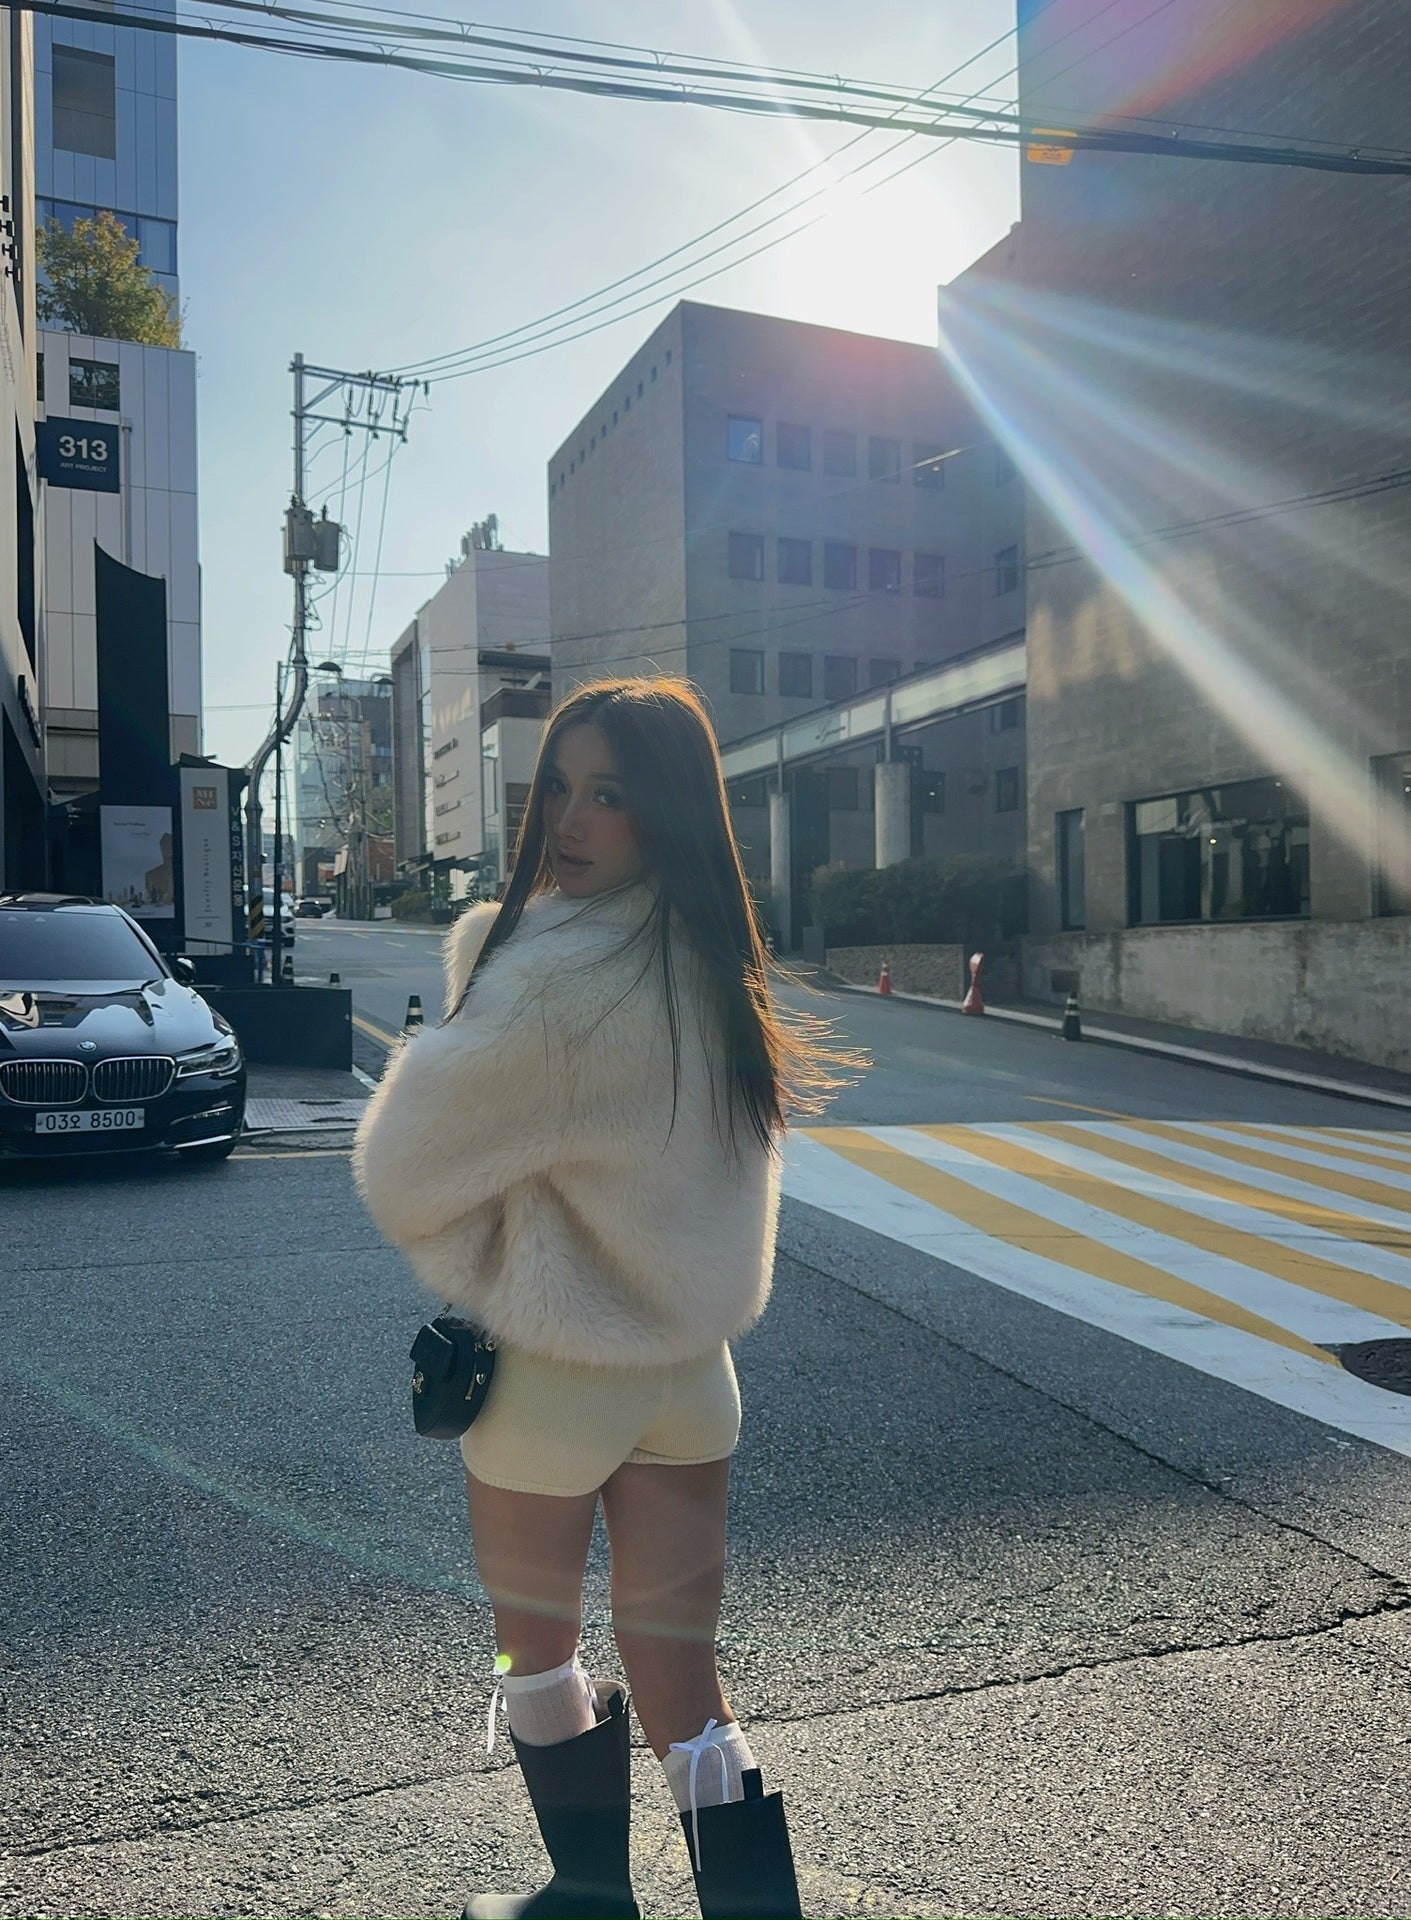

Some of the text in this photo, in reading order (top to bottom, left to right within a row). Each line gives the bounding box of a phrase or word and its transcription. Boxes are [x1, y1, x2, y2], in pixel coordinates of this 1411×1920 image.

[59, 435, 108, 461] 313
[75, 463, 107, 473] PROJECT
[45, 1110, 135, 1131] 03오 8500
